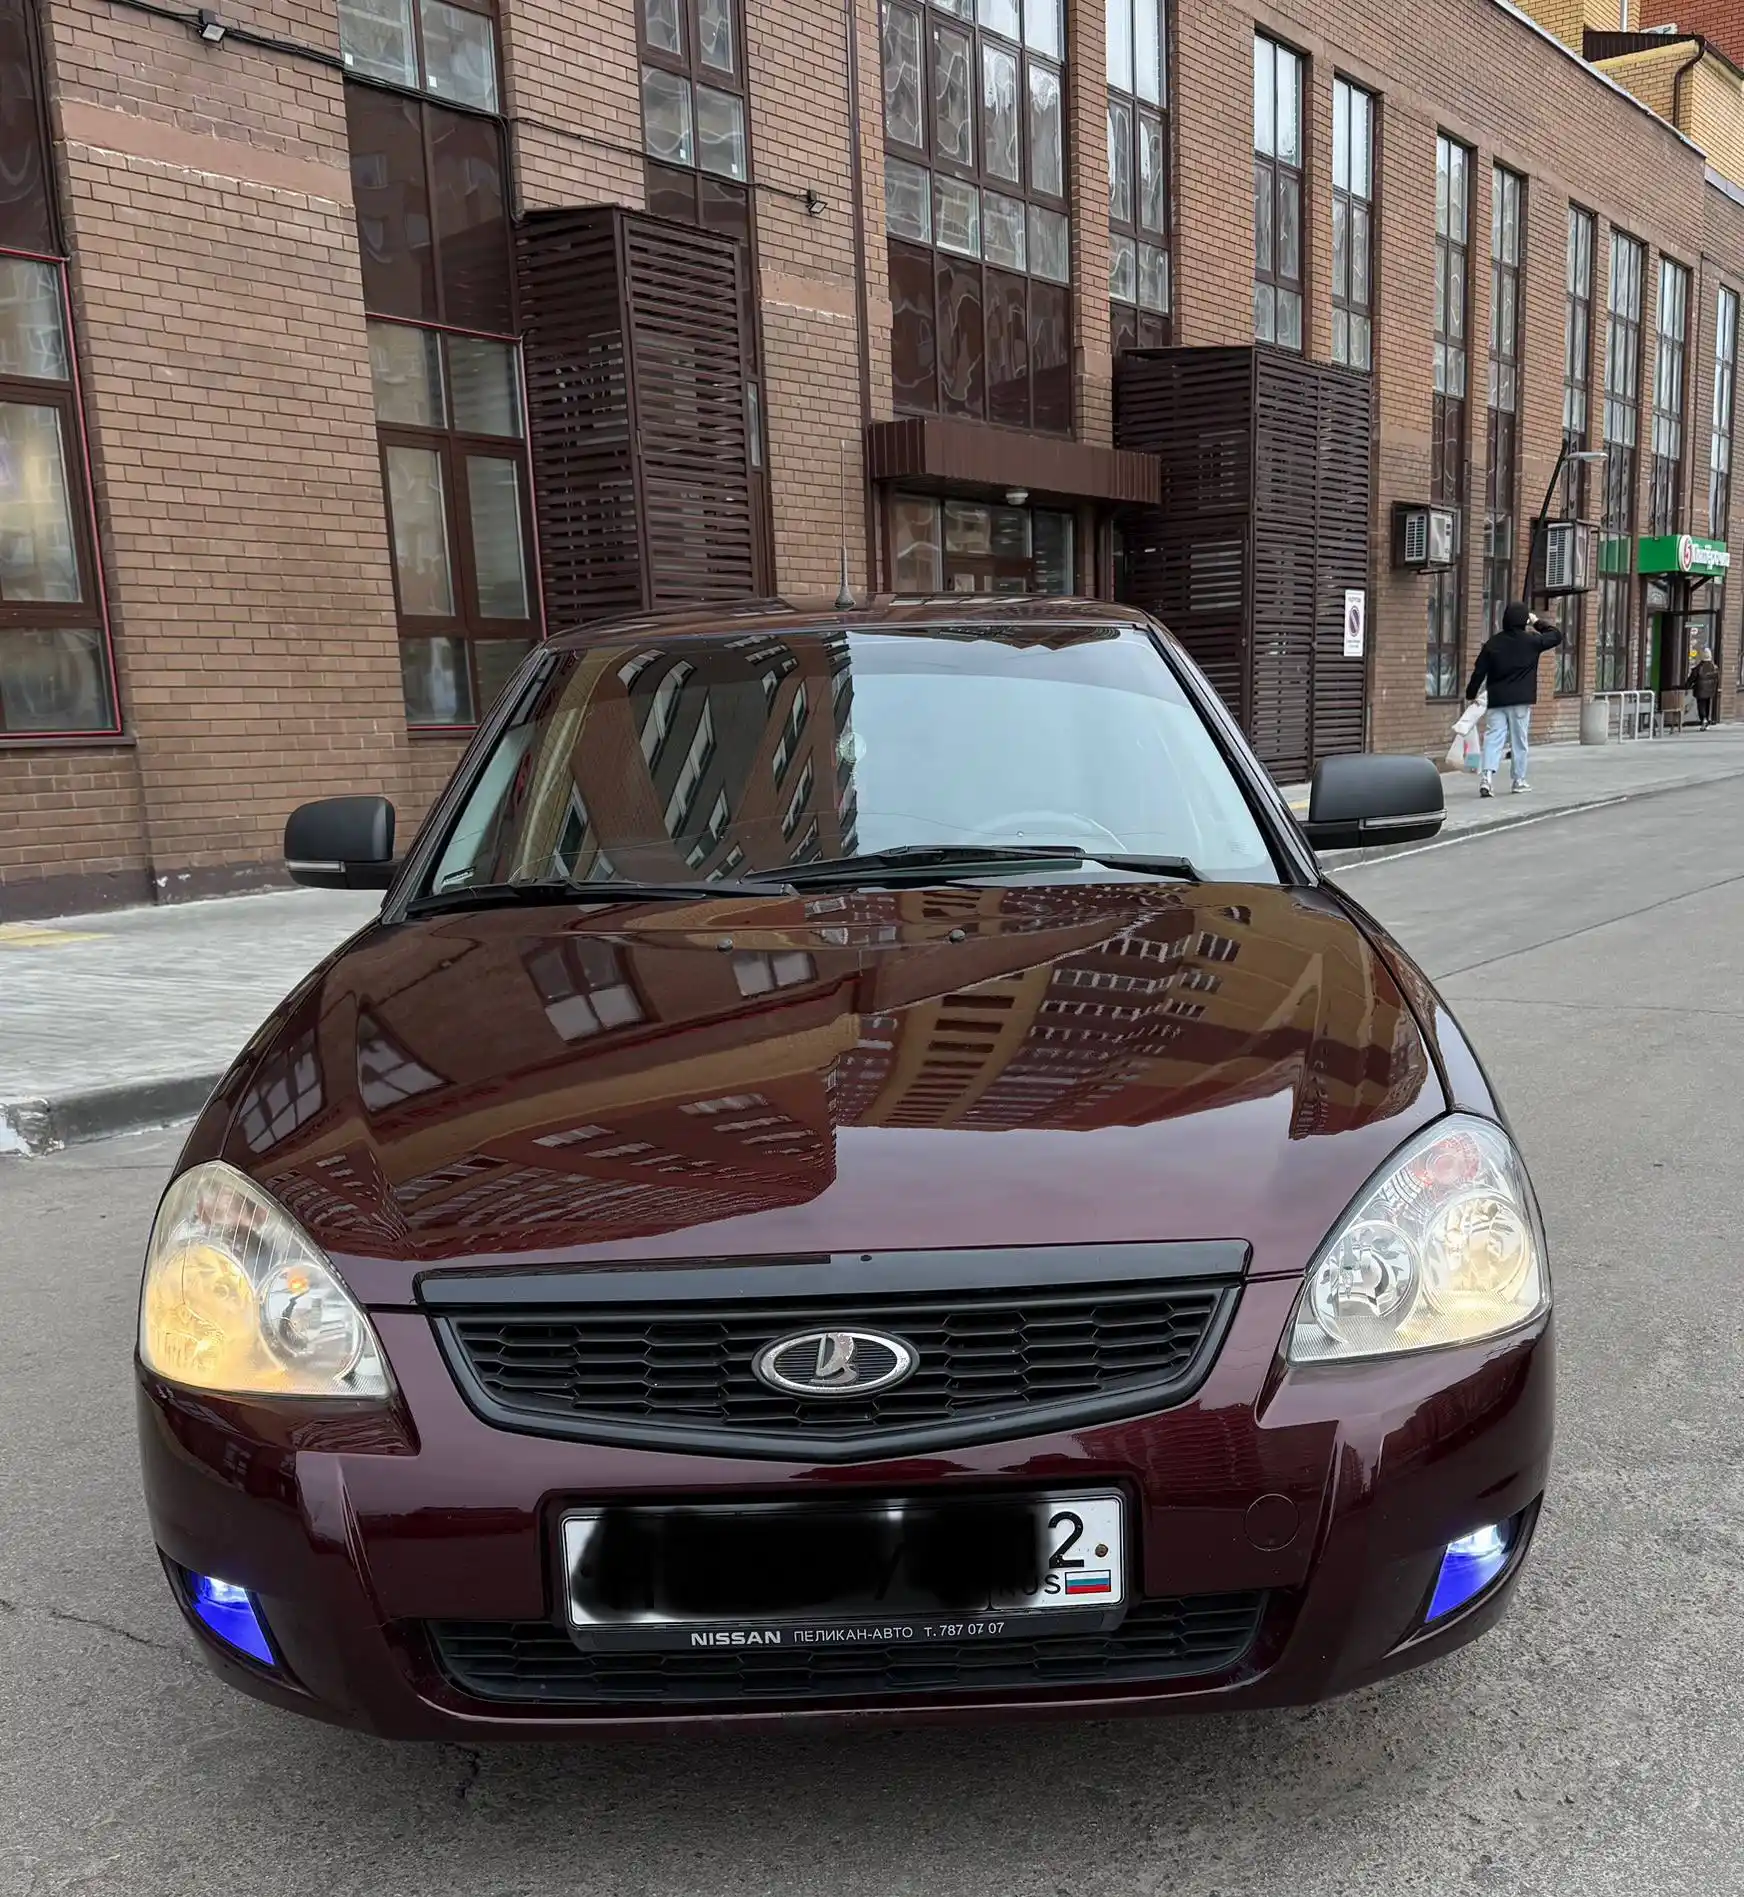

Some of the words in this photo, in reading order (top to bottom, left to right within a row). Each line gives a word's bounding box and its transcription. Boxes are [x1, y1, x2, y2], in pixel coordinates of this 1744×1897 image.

[1048, 1511, 1085, 1569] 2
[1001, 1574, 1062, 1597] US
[691, 1631, 781, 1646] NISSAN
[794, 1627, 913, 1643] ПЕЛИКАН-АВТО
[988, 1622, 1005, 1634] 07
